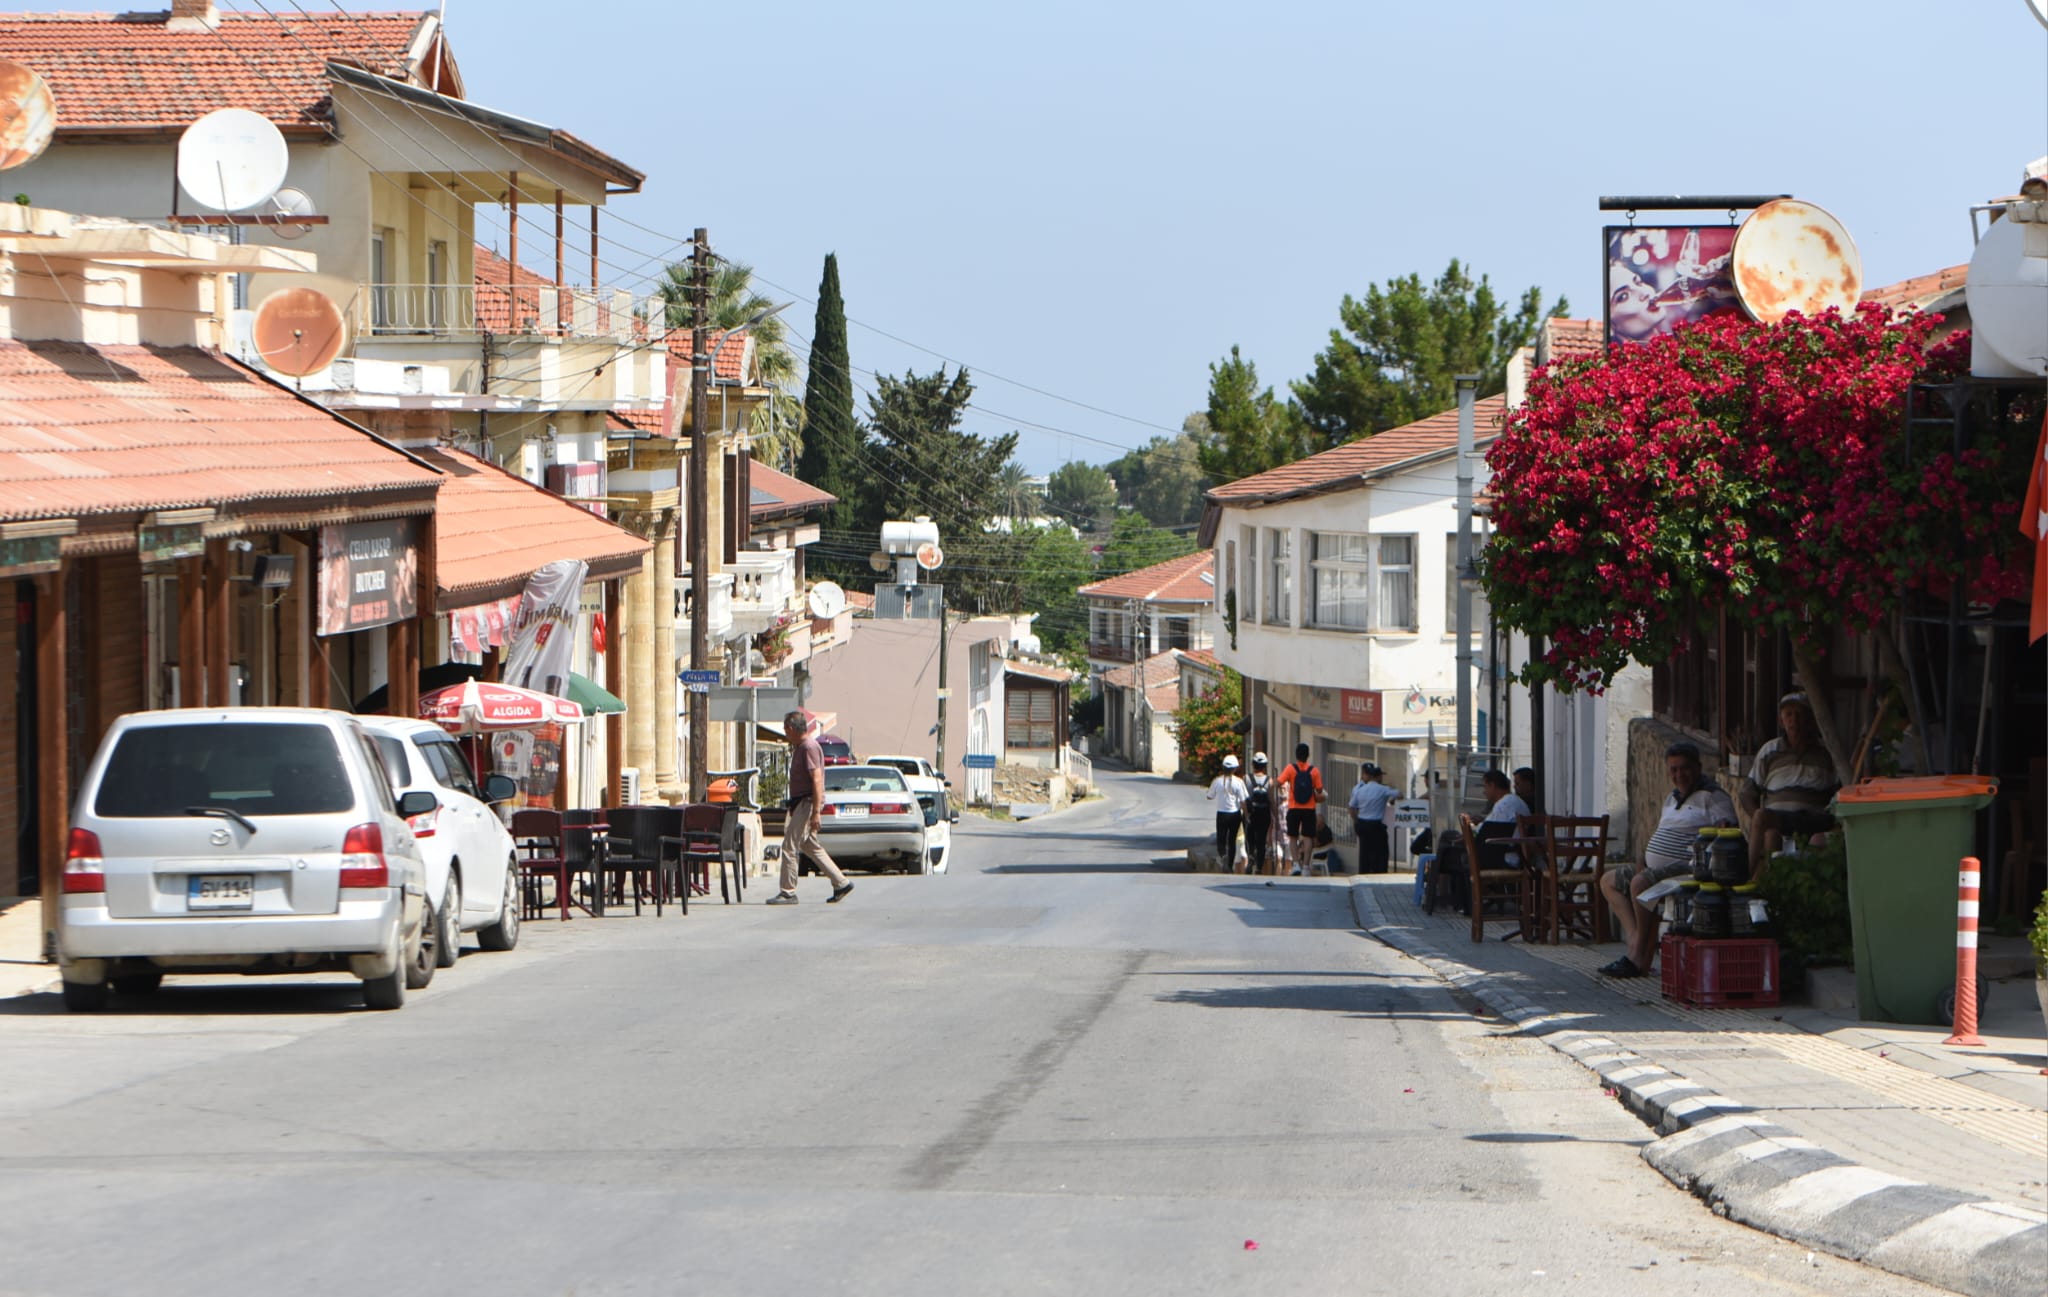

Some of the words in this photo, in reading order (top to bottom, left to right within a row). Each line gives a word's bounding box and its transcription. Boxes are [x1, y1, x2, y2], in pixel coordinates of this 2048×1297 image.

[355, 570, 386, 593] BUTCHER
[1348, 695, 1374, 712] KULE
[1430, 695, 1457, 707] Kal
[493, 706, 532, 716] ALGIDA
[1395, 813, 1412, 822] PARK
